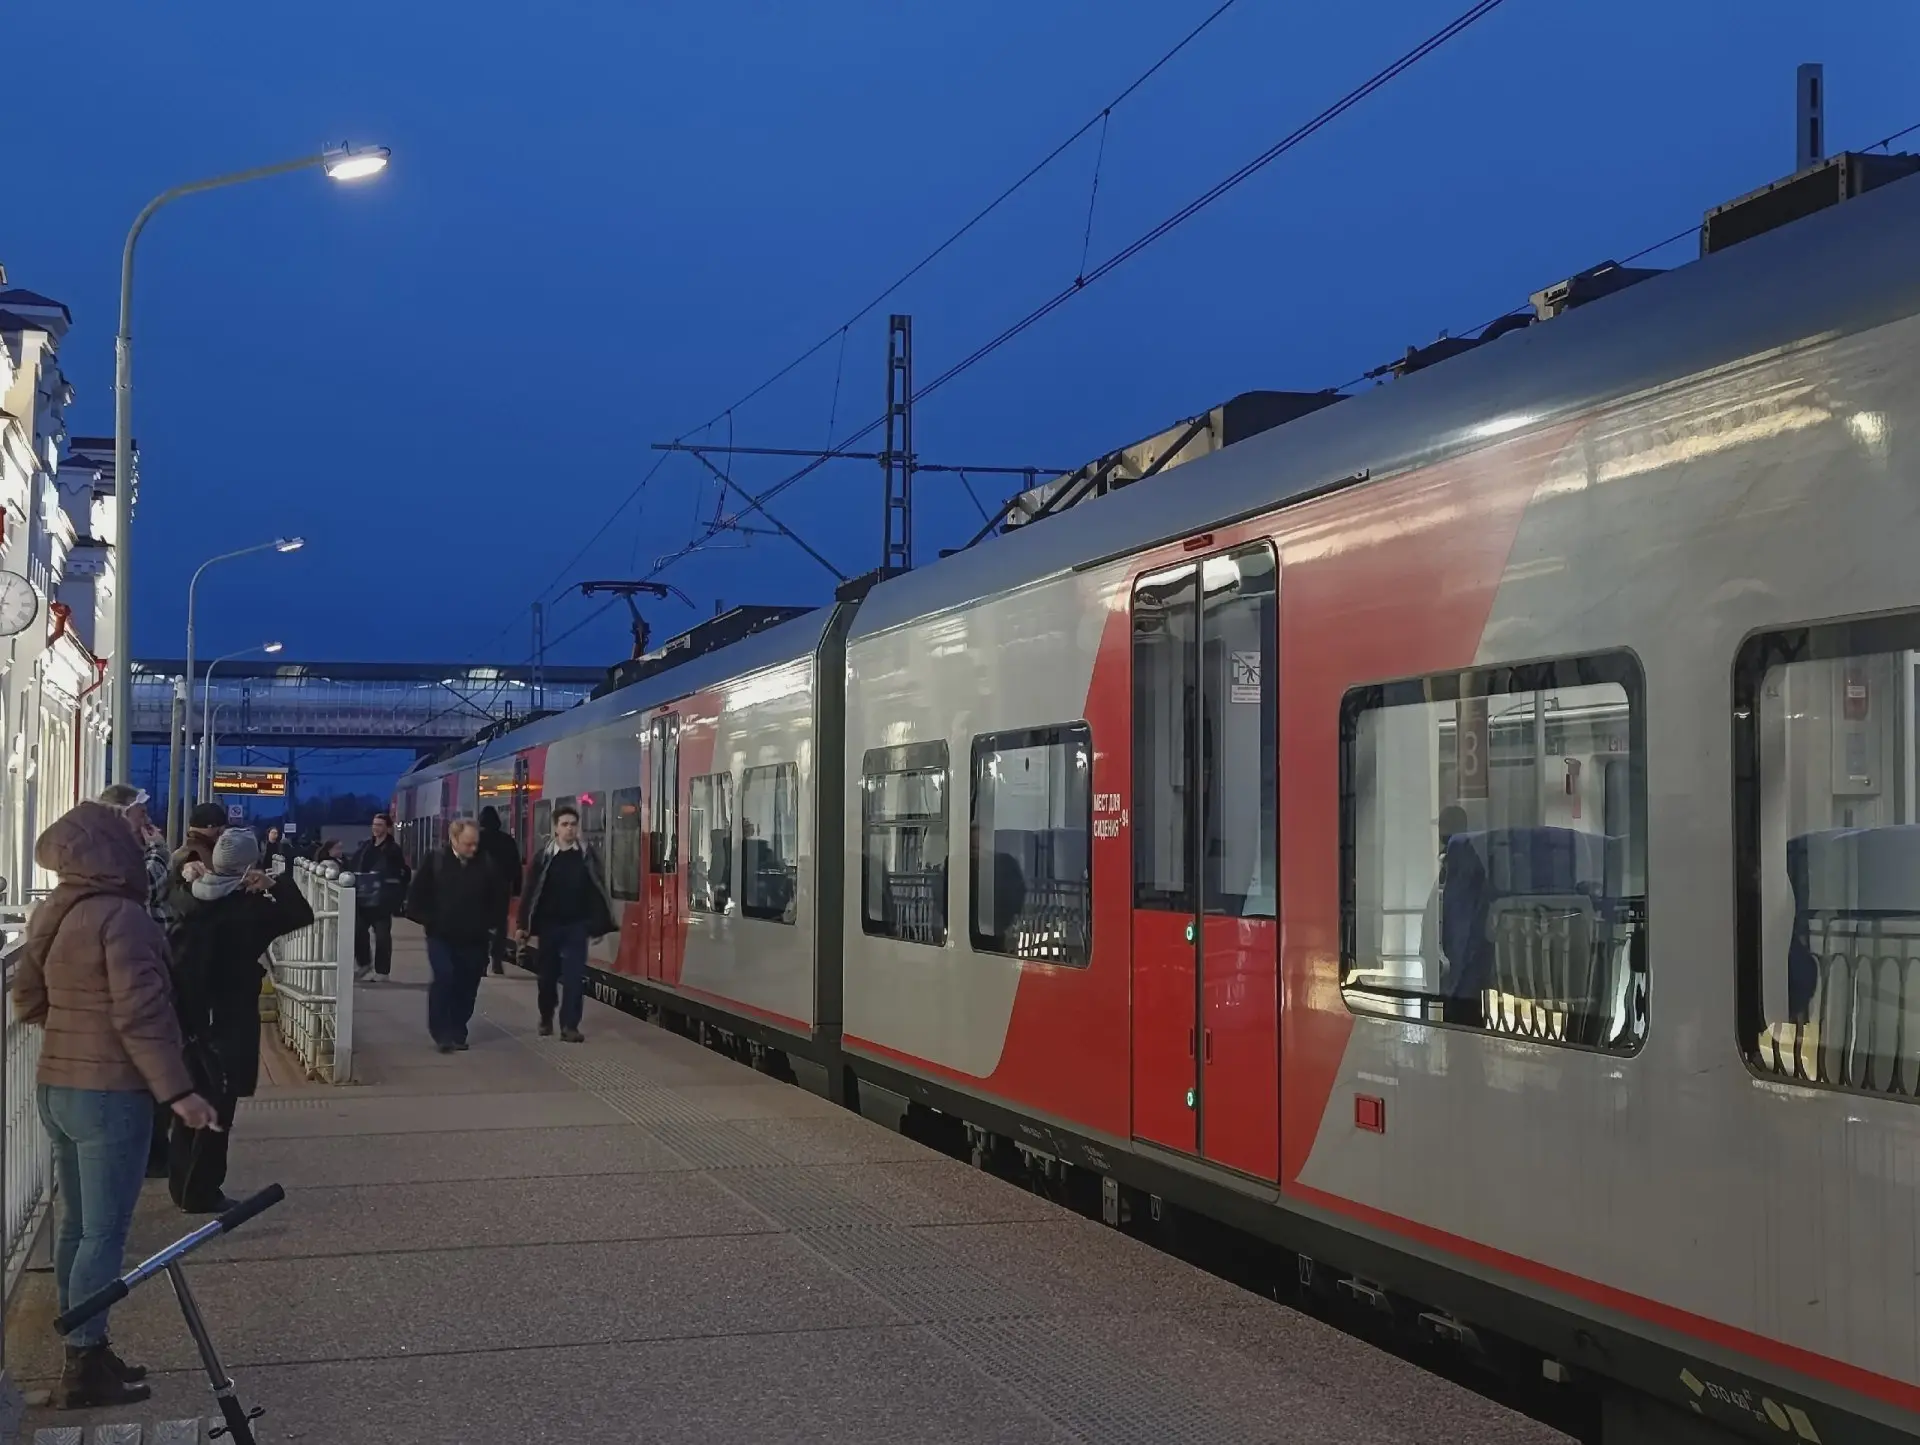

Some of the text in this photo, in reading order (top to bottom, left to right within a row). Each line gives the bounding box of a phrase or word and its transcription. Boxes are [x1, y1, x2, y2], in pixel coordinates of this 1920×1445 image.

[1094, 794, 1120, 814] МЕСТ ДЛЯ
[1094, 820, 1119, 840] СИДЕНИЯ
